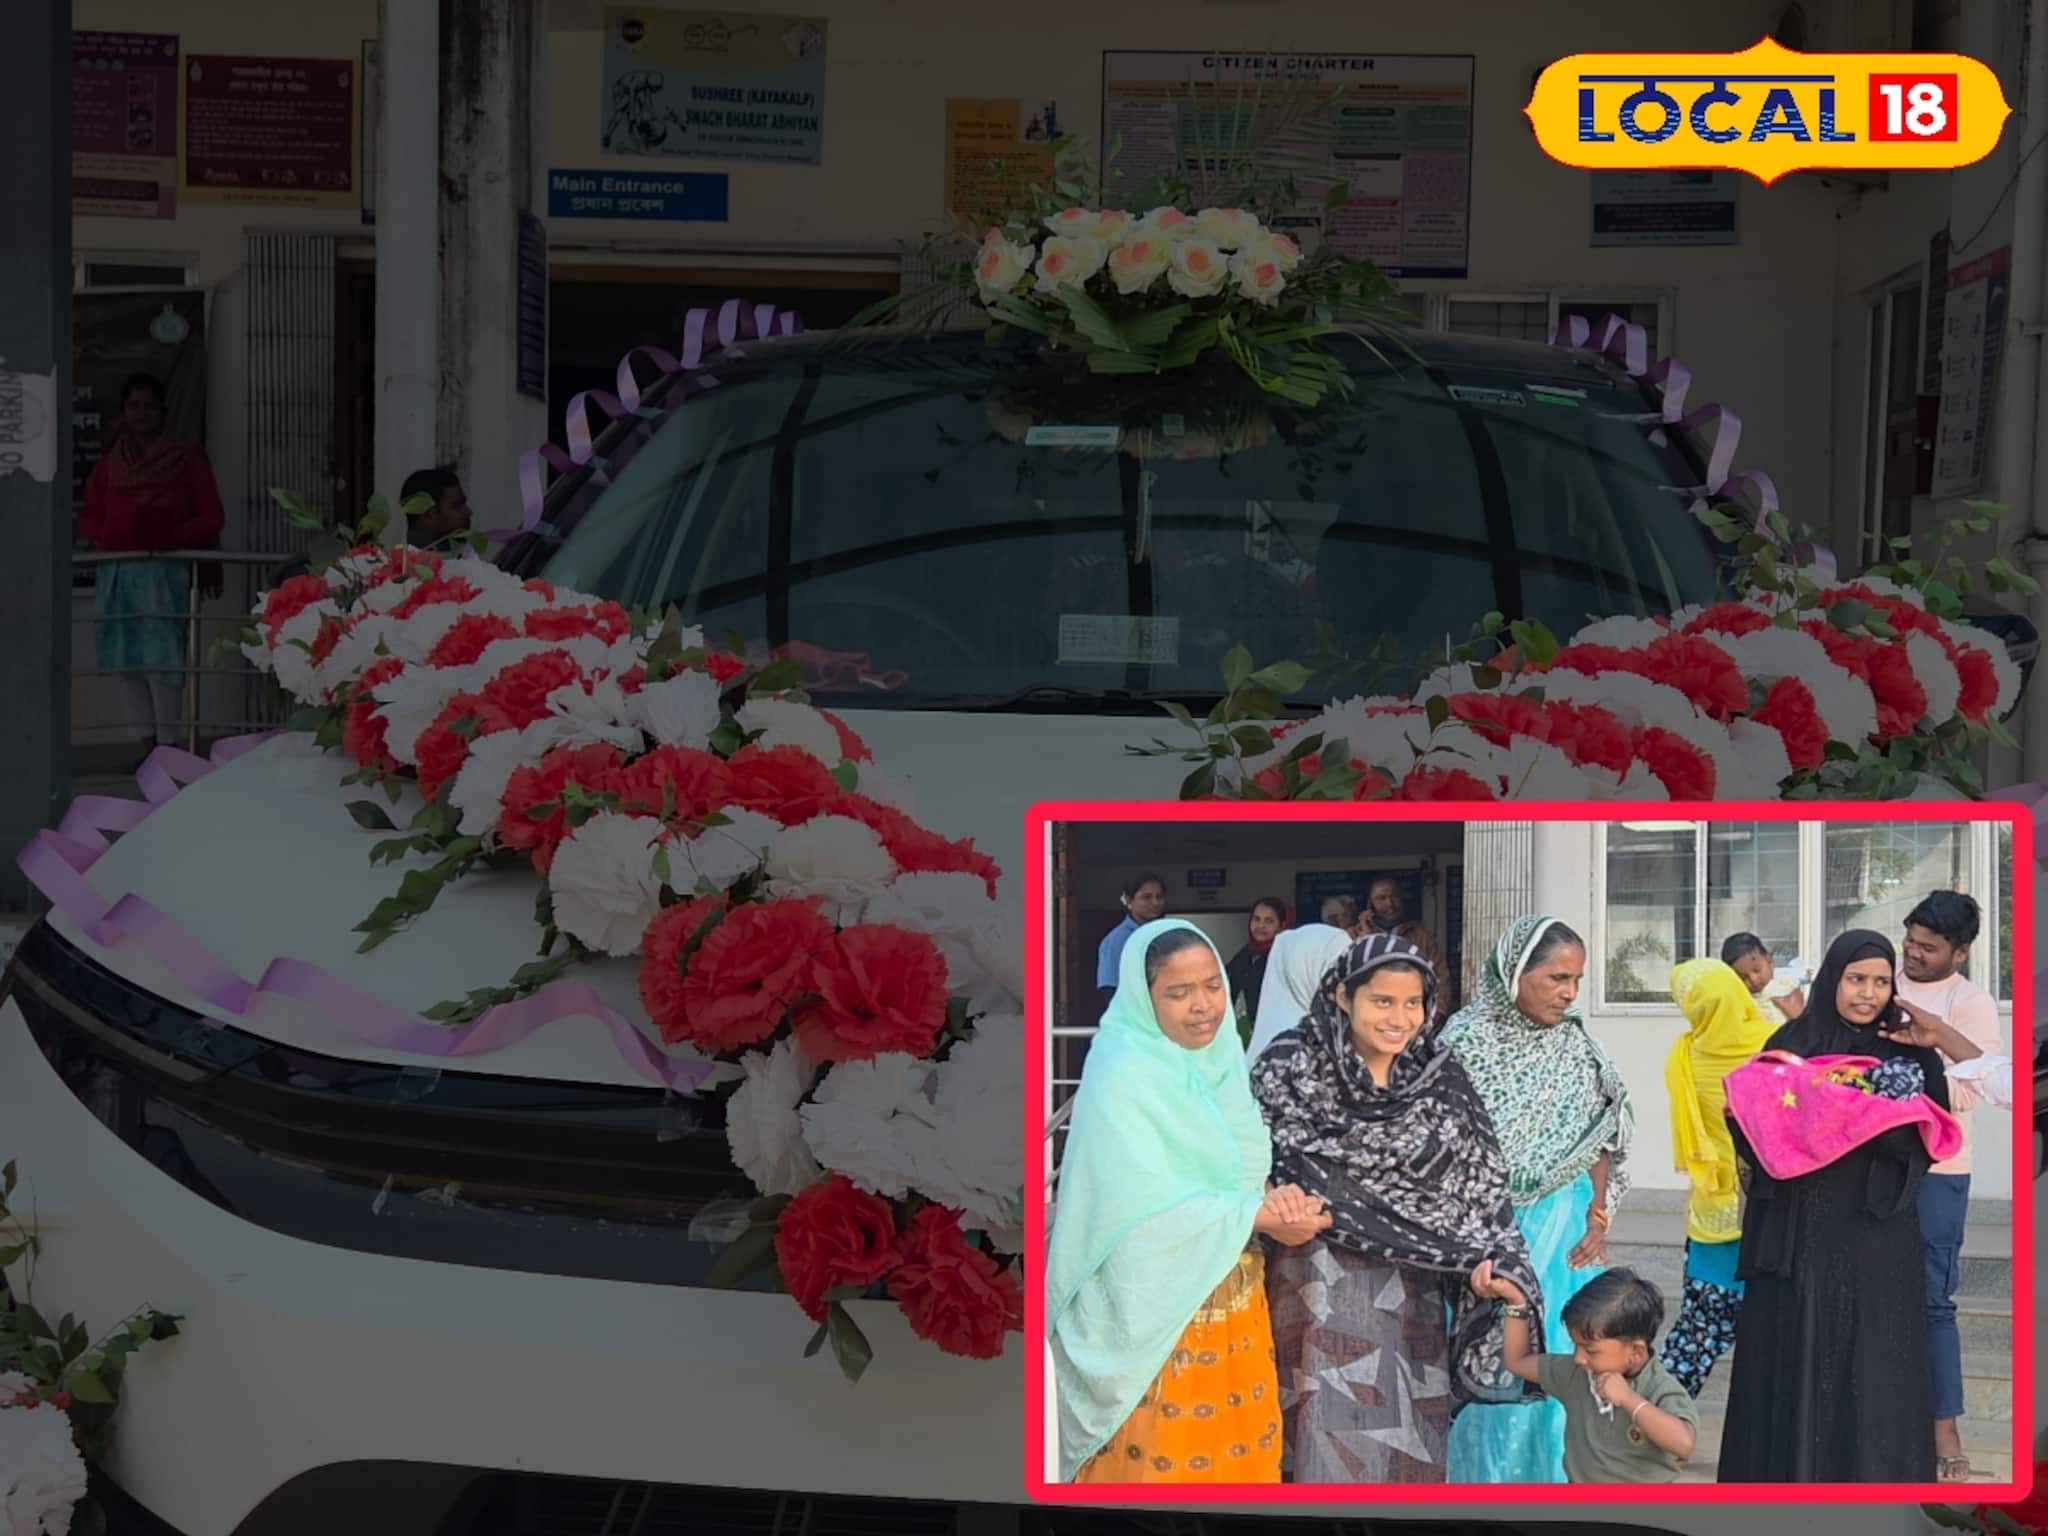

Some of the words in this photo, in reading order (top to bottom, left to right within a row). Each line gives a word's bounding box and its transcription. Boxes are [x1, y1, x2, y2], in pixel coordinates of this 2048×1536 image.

[1286, 58, 1375, 70] CHARTER
[691, 86, 744, 103] SUSHREE
[747, 88, 815, 110] (KAYAKALP)
[686, 109, 723, 126] SWACH
[726, 112, 768, 128] BHARAT
[772, 115, 819, 130] ABHIYAN
[553, 176, 597, 192] Main
[602, 177, 685, 194] Entrance
[0, 371, 24, 445] PARKIN
